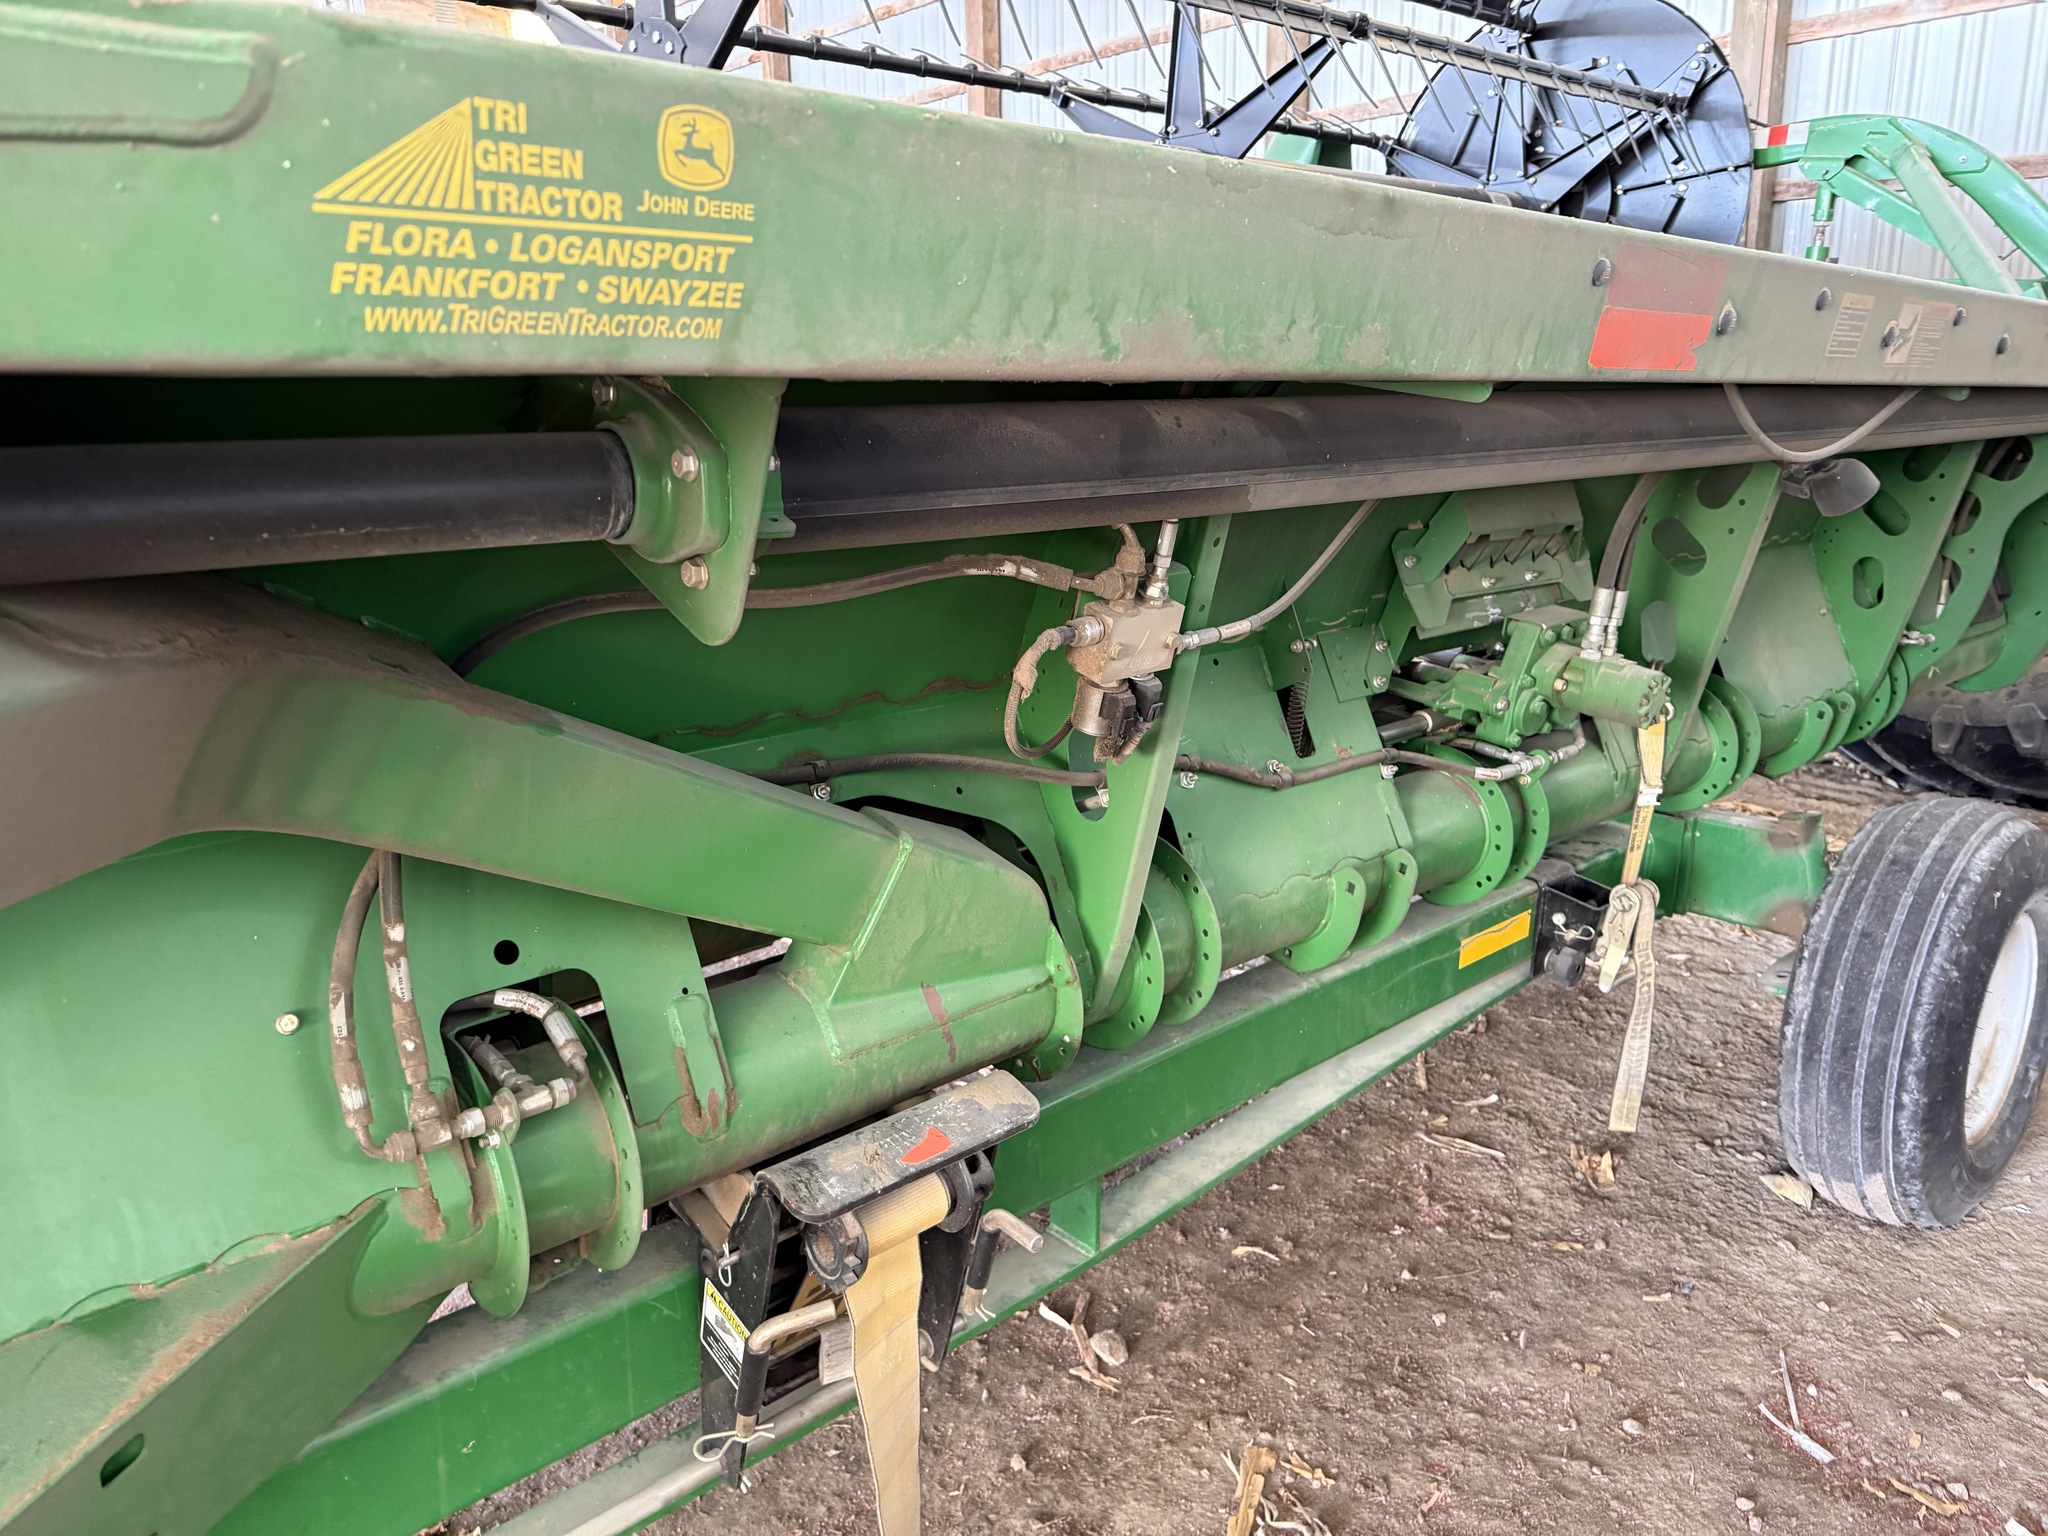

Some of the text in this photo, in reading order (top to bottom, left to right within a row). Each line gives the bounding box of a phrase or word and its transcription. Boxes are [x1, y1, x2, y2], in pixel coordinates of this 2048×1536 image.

[473, 96, 528, 134] TRI
[474, 139, 584, 180] GREEN
[475, 180, 623, 222] TRACTOR
[637, 190, 755, 221] JOHN DEERE
[346, 221, 735, 274] FLORA LOGANSPORT
[330, 262, 745, 309] FRANKFORT SWAYZEE
[718, 1301, 748, 1341] CAUTION
